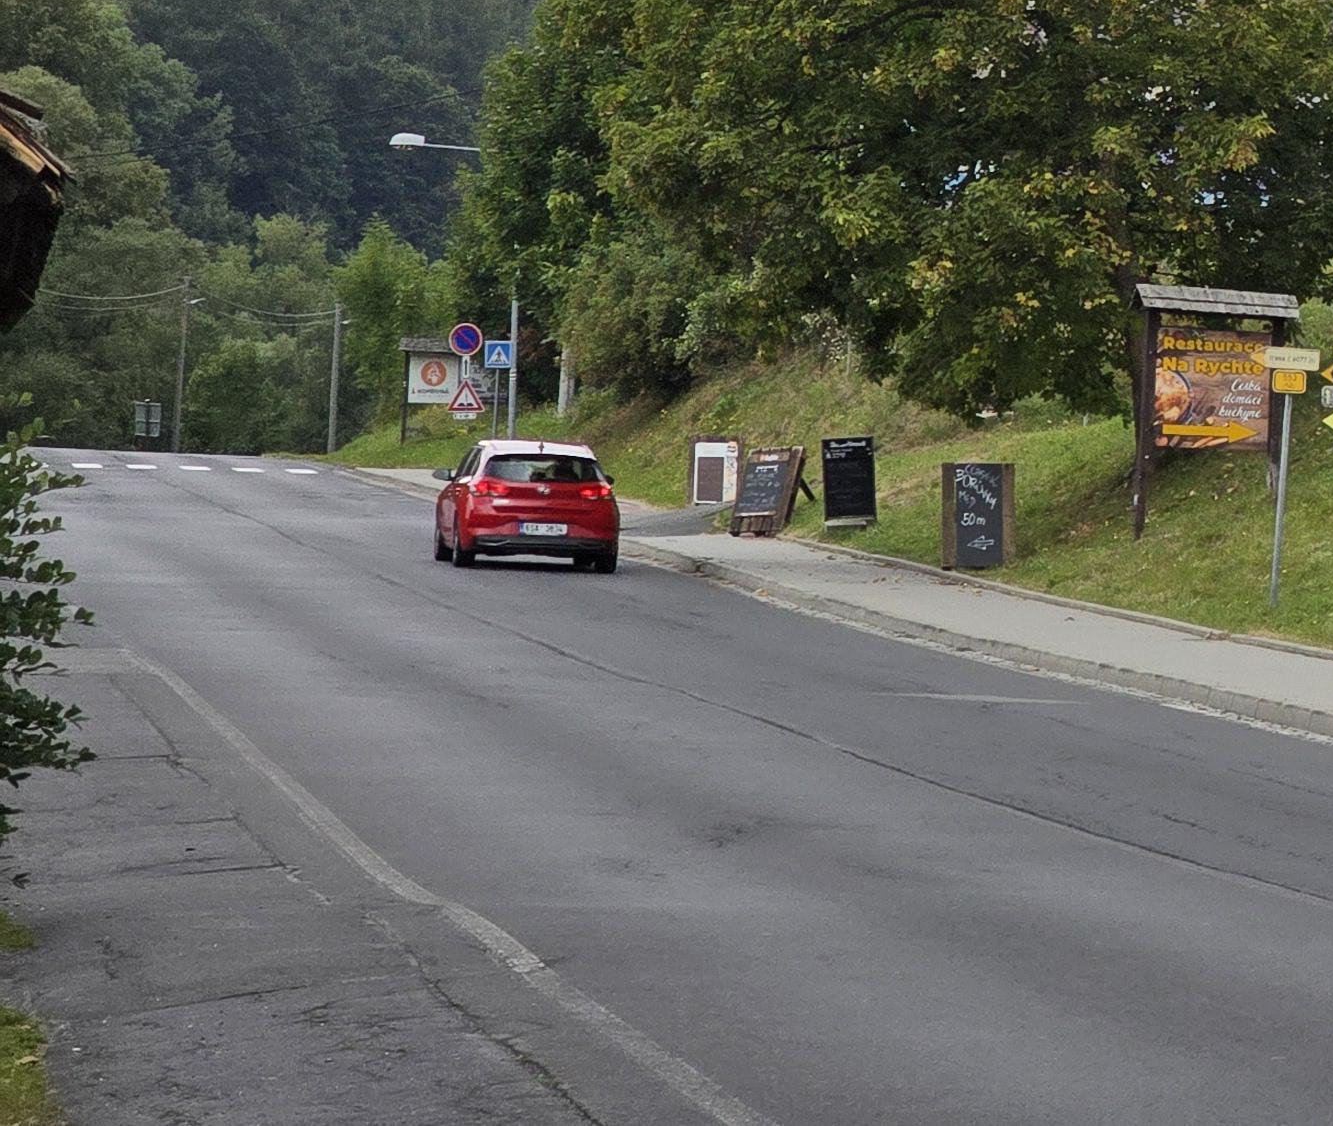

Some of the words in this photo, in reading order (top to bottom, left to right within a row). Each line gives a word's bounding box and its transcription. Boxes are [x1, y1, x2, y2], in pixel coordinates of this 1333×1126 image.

[1163, 335, 1266, 353] Restaurace
[1162, 356, 1188, 372] Na
[960, 512, 976, 526] 50
[976, 517, 986, 526] m
